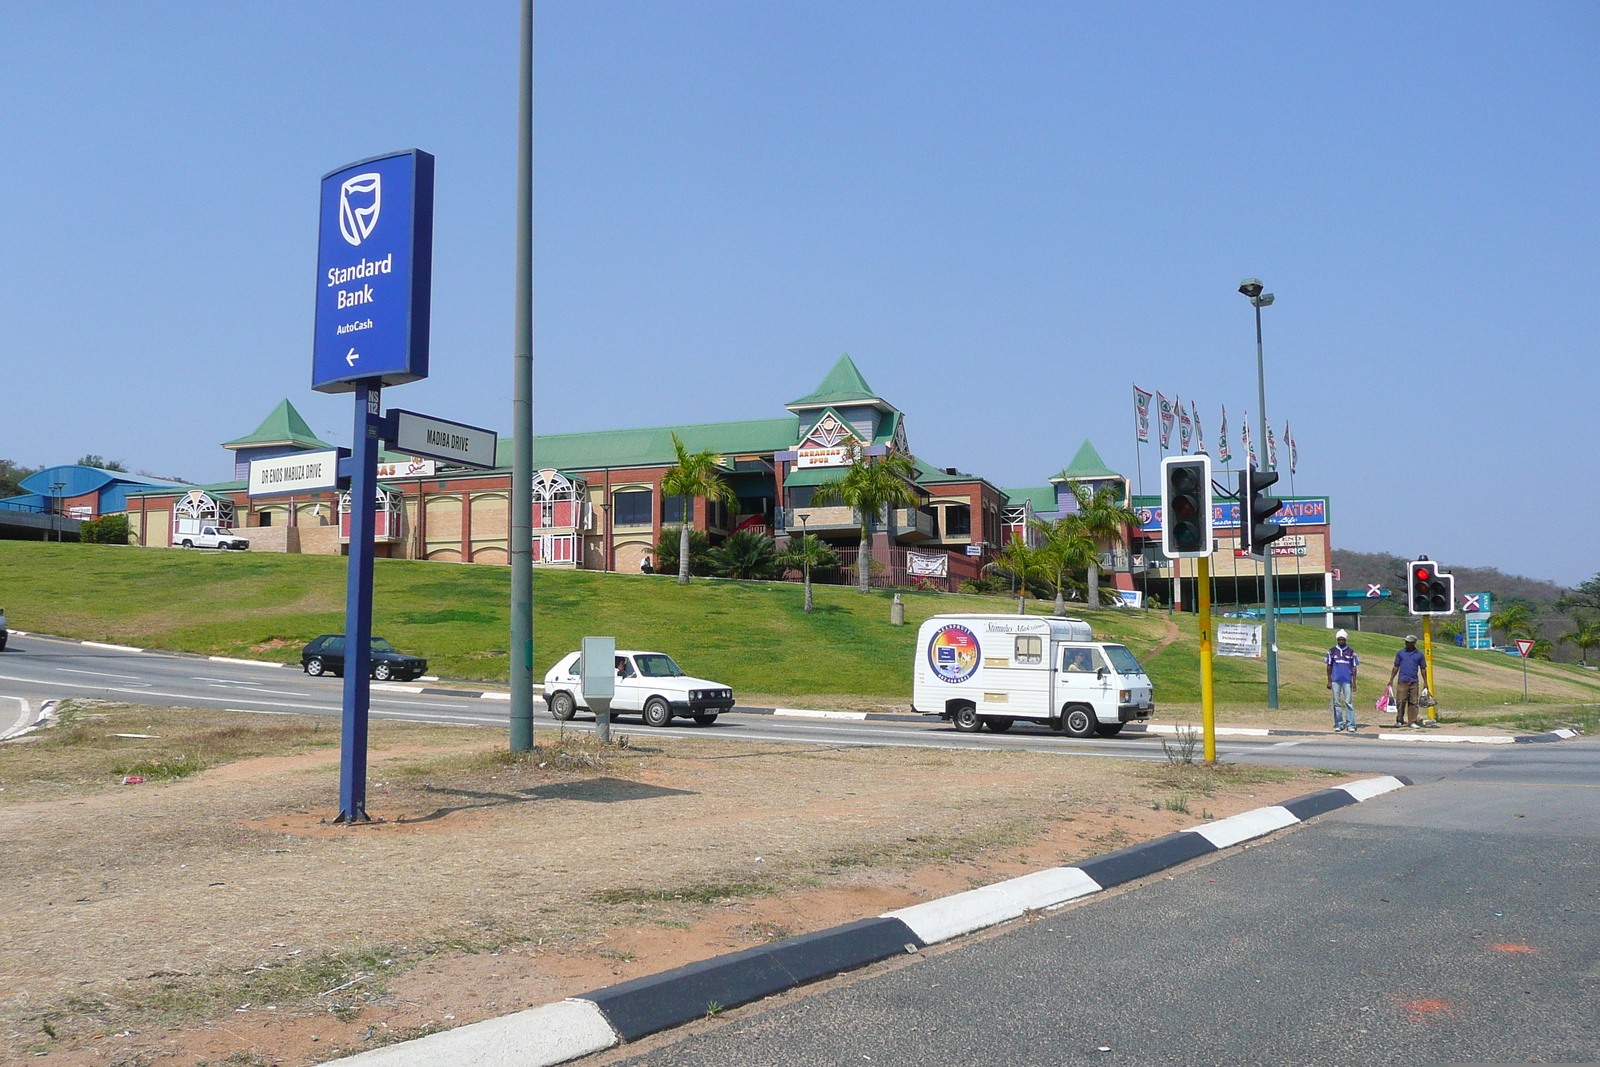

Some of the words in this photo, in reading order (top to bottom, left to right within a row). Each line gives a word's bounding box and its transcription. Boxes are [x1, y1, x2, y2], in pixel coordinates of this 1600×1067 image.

[327, 253, 392, 287] Standard
[337, 283, 374, 310] Bank
[336, 318, 373, 335] AutoCash
[368, 390, 379, 403] NS
[368, 402, 379, 415] 112
[426, 429, 450, 448] MADIBA
[450, 436, 469, 452] DRIVE
[799, 449, 841, 457] ARKANSAS
[261, 469, 269, 484] DR
[269, 467, 283, 483] ENOS
[284, 465, 305, 482] MABUZA
[305, 463, 322, 479] DRIVE
[1202, 630, 1207, 641] 1
